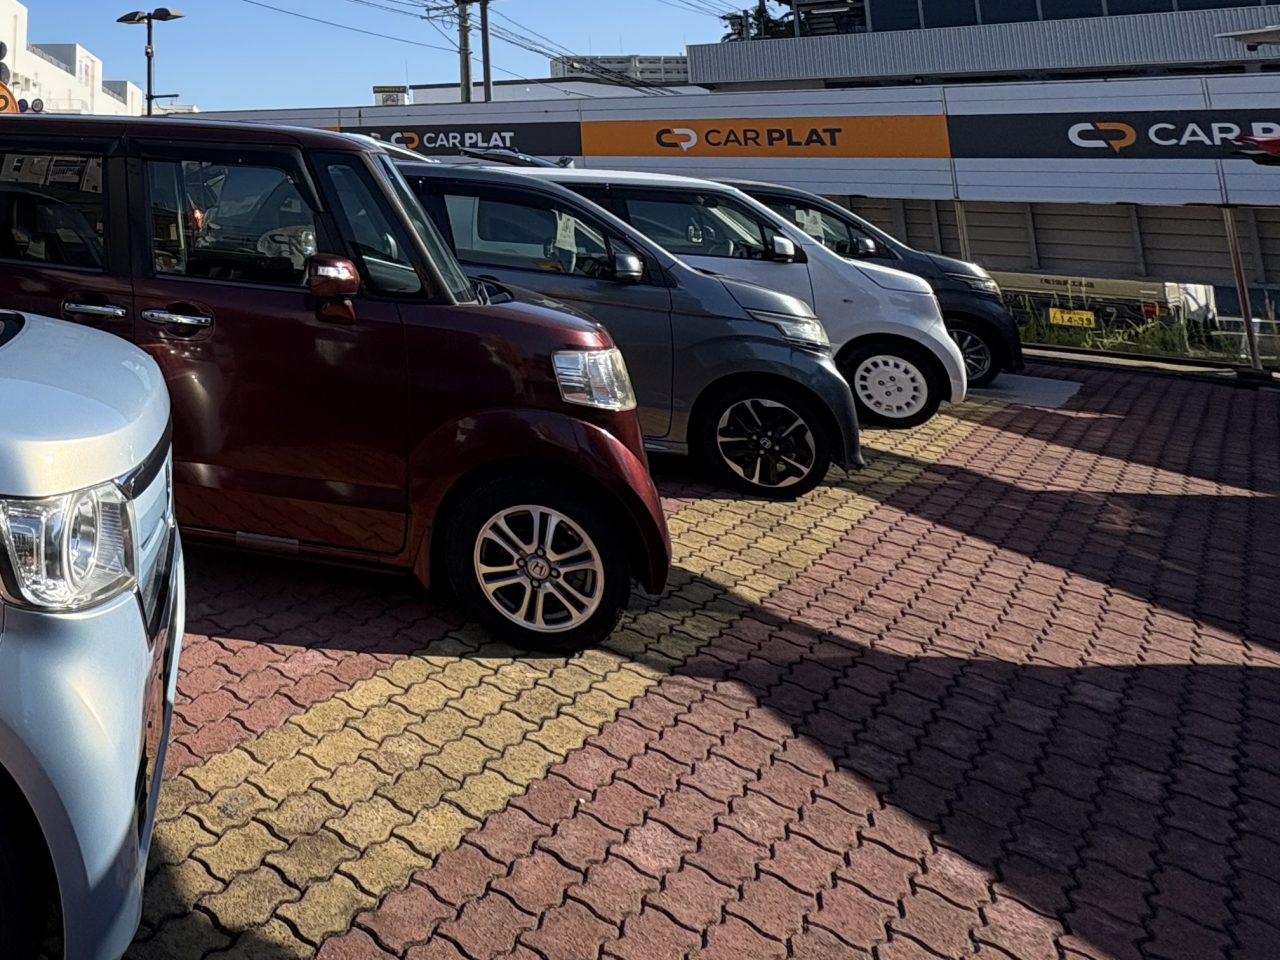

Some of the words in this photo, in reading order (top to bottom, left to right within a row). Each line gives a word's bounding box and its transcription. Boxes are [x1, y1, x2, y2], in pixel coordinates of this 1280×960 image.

[423, 133, 461, 148] CAR
[464, 132, 515, 147] PLAT
[704, 129, 761, 147] CAR
[767, 128, 842, 146] PLAT
[1148, 122, 1244, 146] CAR
